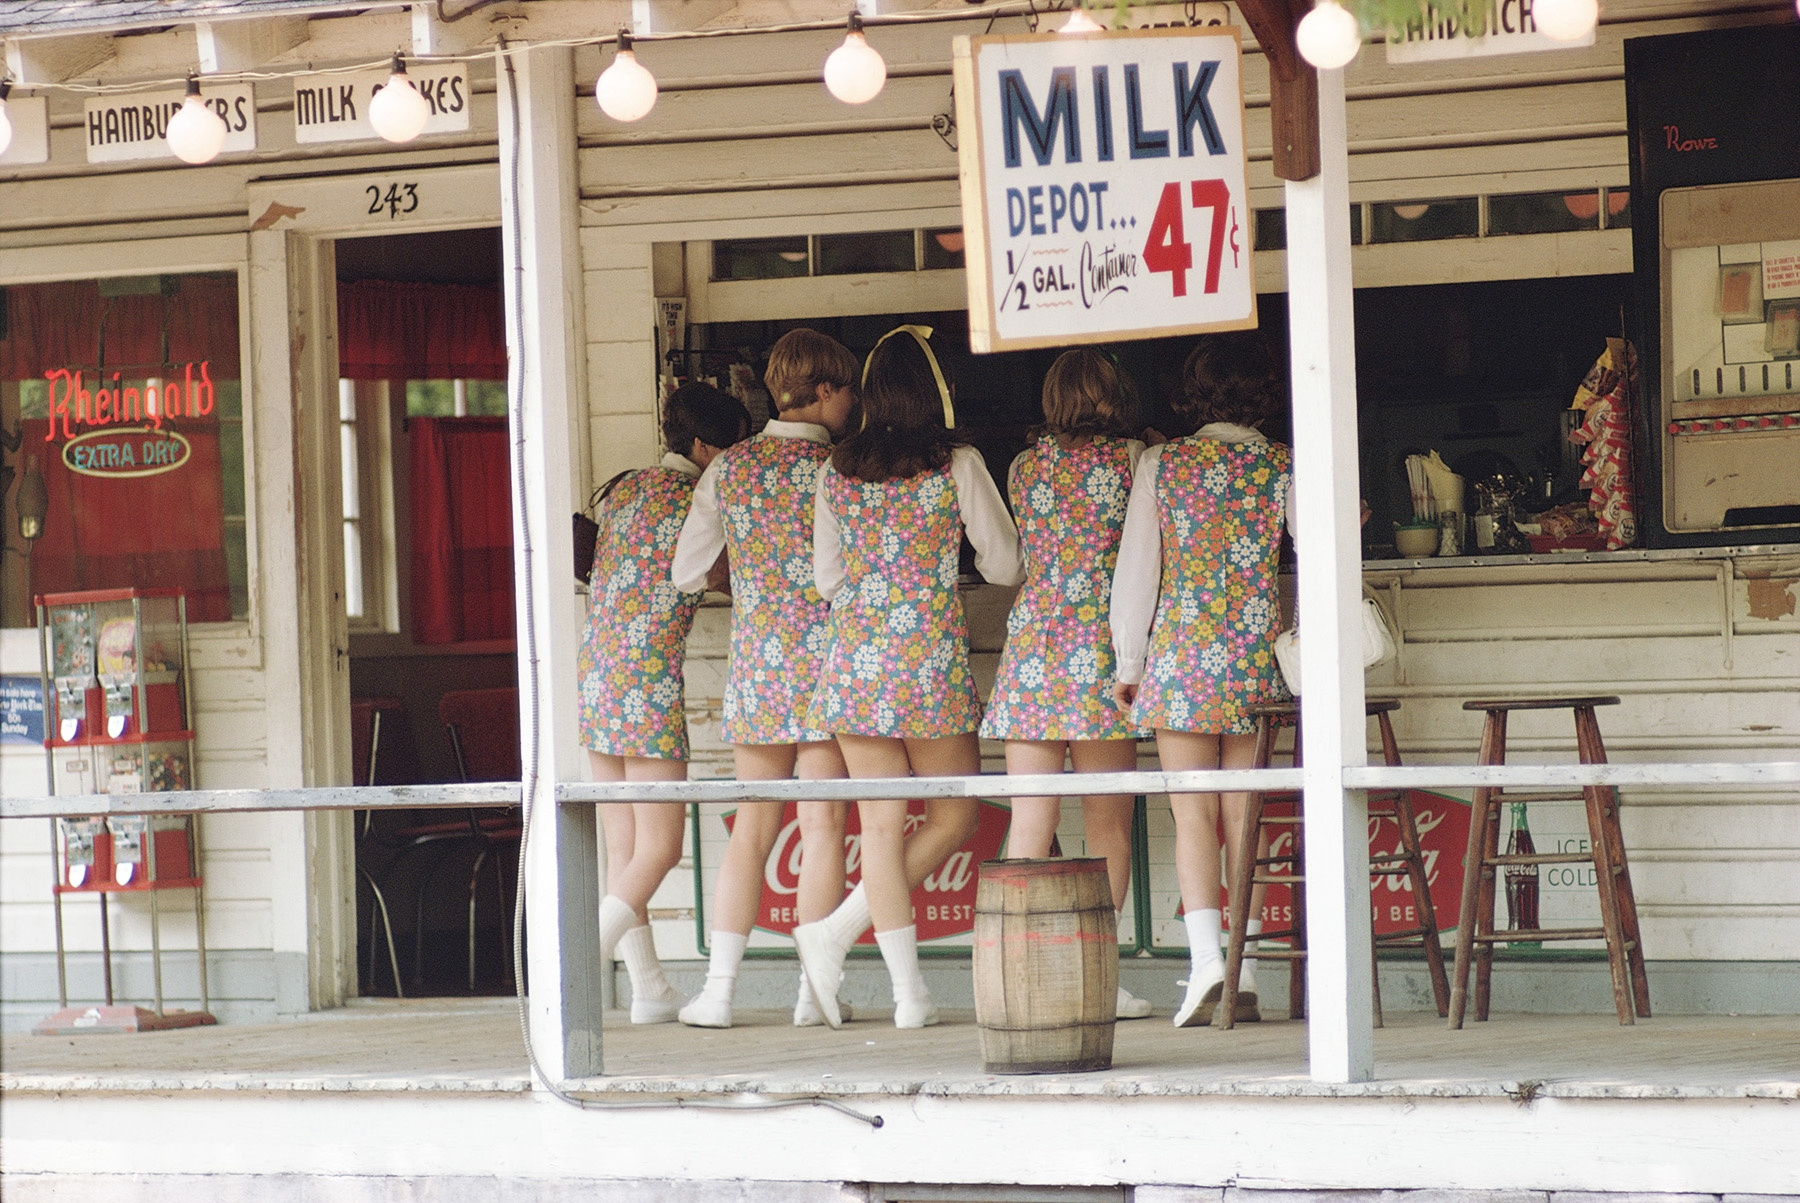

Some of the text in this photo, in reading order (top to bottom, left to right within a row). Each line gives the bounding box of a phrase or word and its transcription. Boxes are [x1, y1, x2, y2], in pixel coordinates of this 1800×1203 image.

[297, 84, 357, 126] MILK
[998, 60, 1228, 168] MILK
[366, 182, 419, 219] 243
[1032, 264, 1075, 293] GAL.
[1079, 240, 1138, 309] Container
[45, 361, 214, 442] Rheingold
[74, 440, 180, 469] EXTRA DRY
[1548, 868, 1598, 887] COLD
[926, 905, 972, 921] BEST
